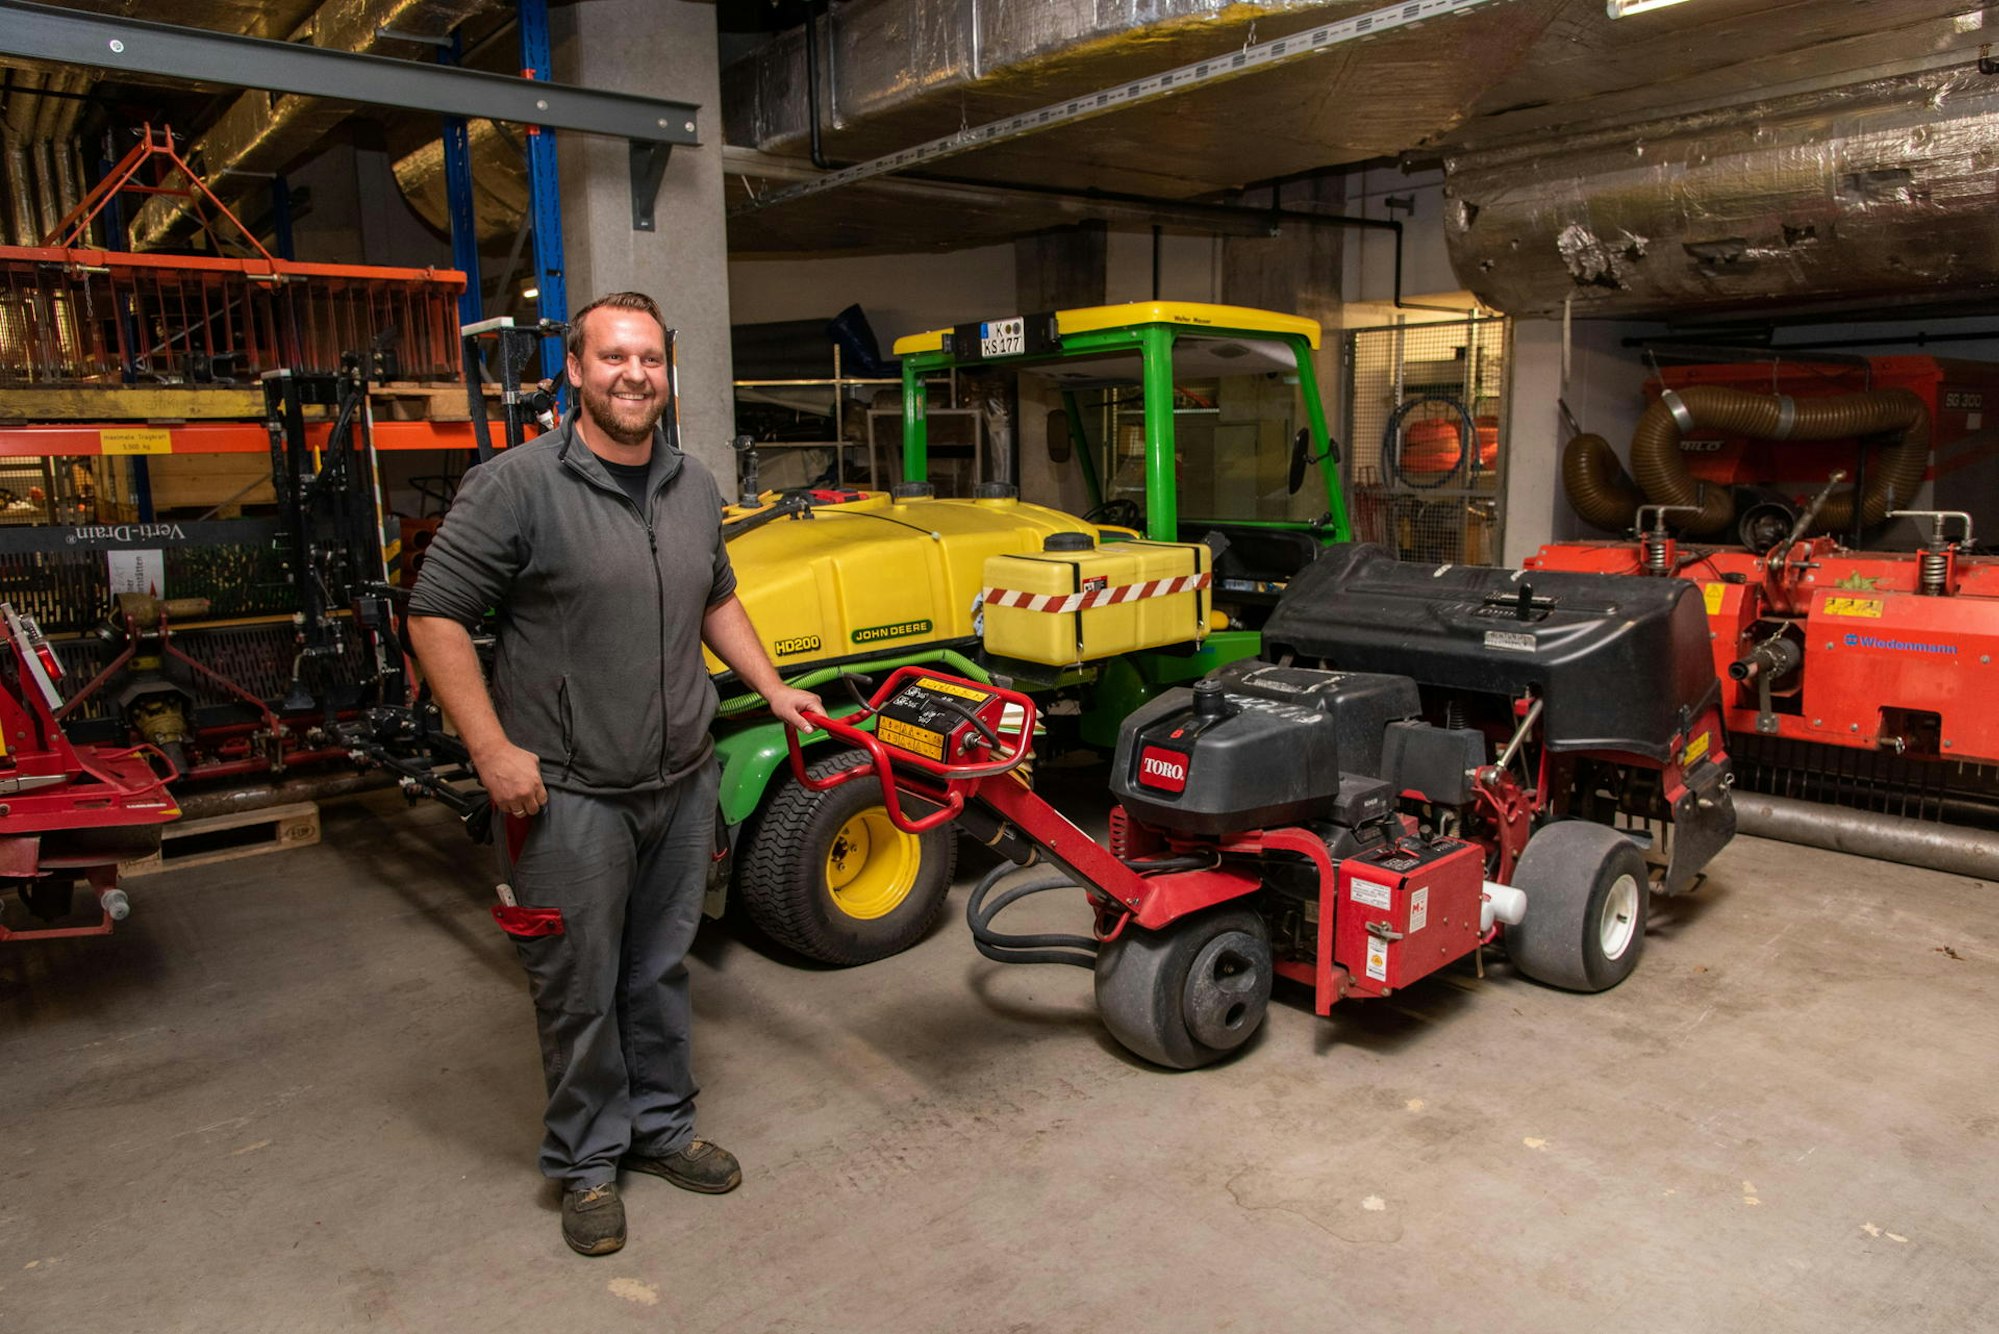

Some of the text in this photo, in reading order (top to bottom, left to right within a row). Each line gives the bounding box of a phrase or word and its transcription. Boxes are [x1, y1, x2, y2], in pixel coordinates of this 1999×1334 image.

[996, 323, 1004, 338] K
[983, 337, 1021, 355] KS 177
[856, 621, 927, 641] JOHN DEERE
[775, 635, 821, 656] HD200
[1860, 635, 1957, 655] Wiedenmann
[1144, 757, 1184, 781] TORO
